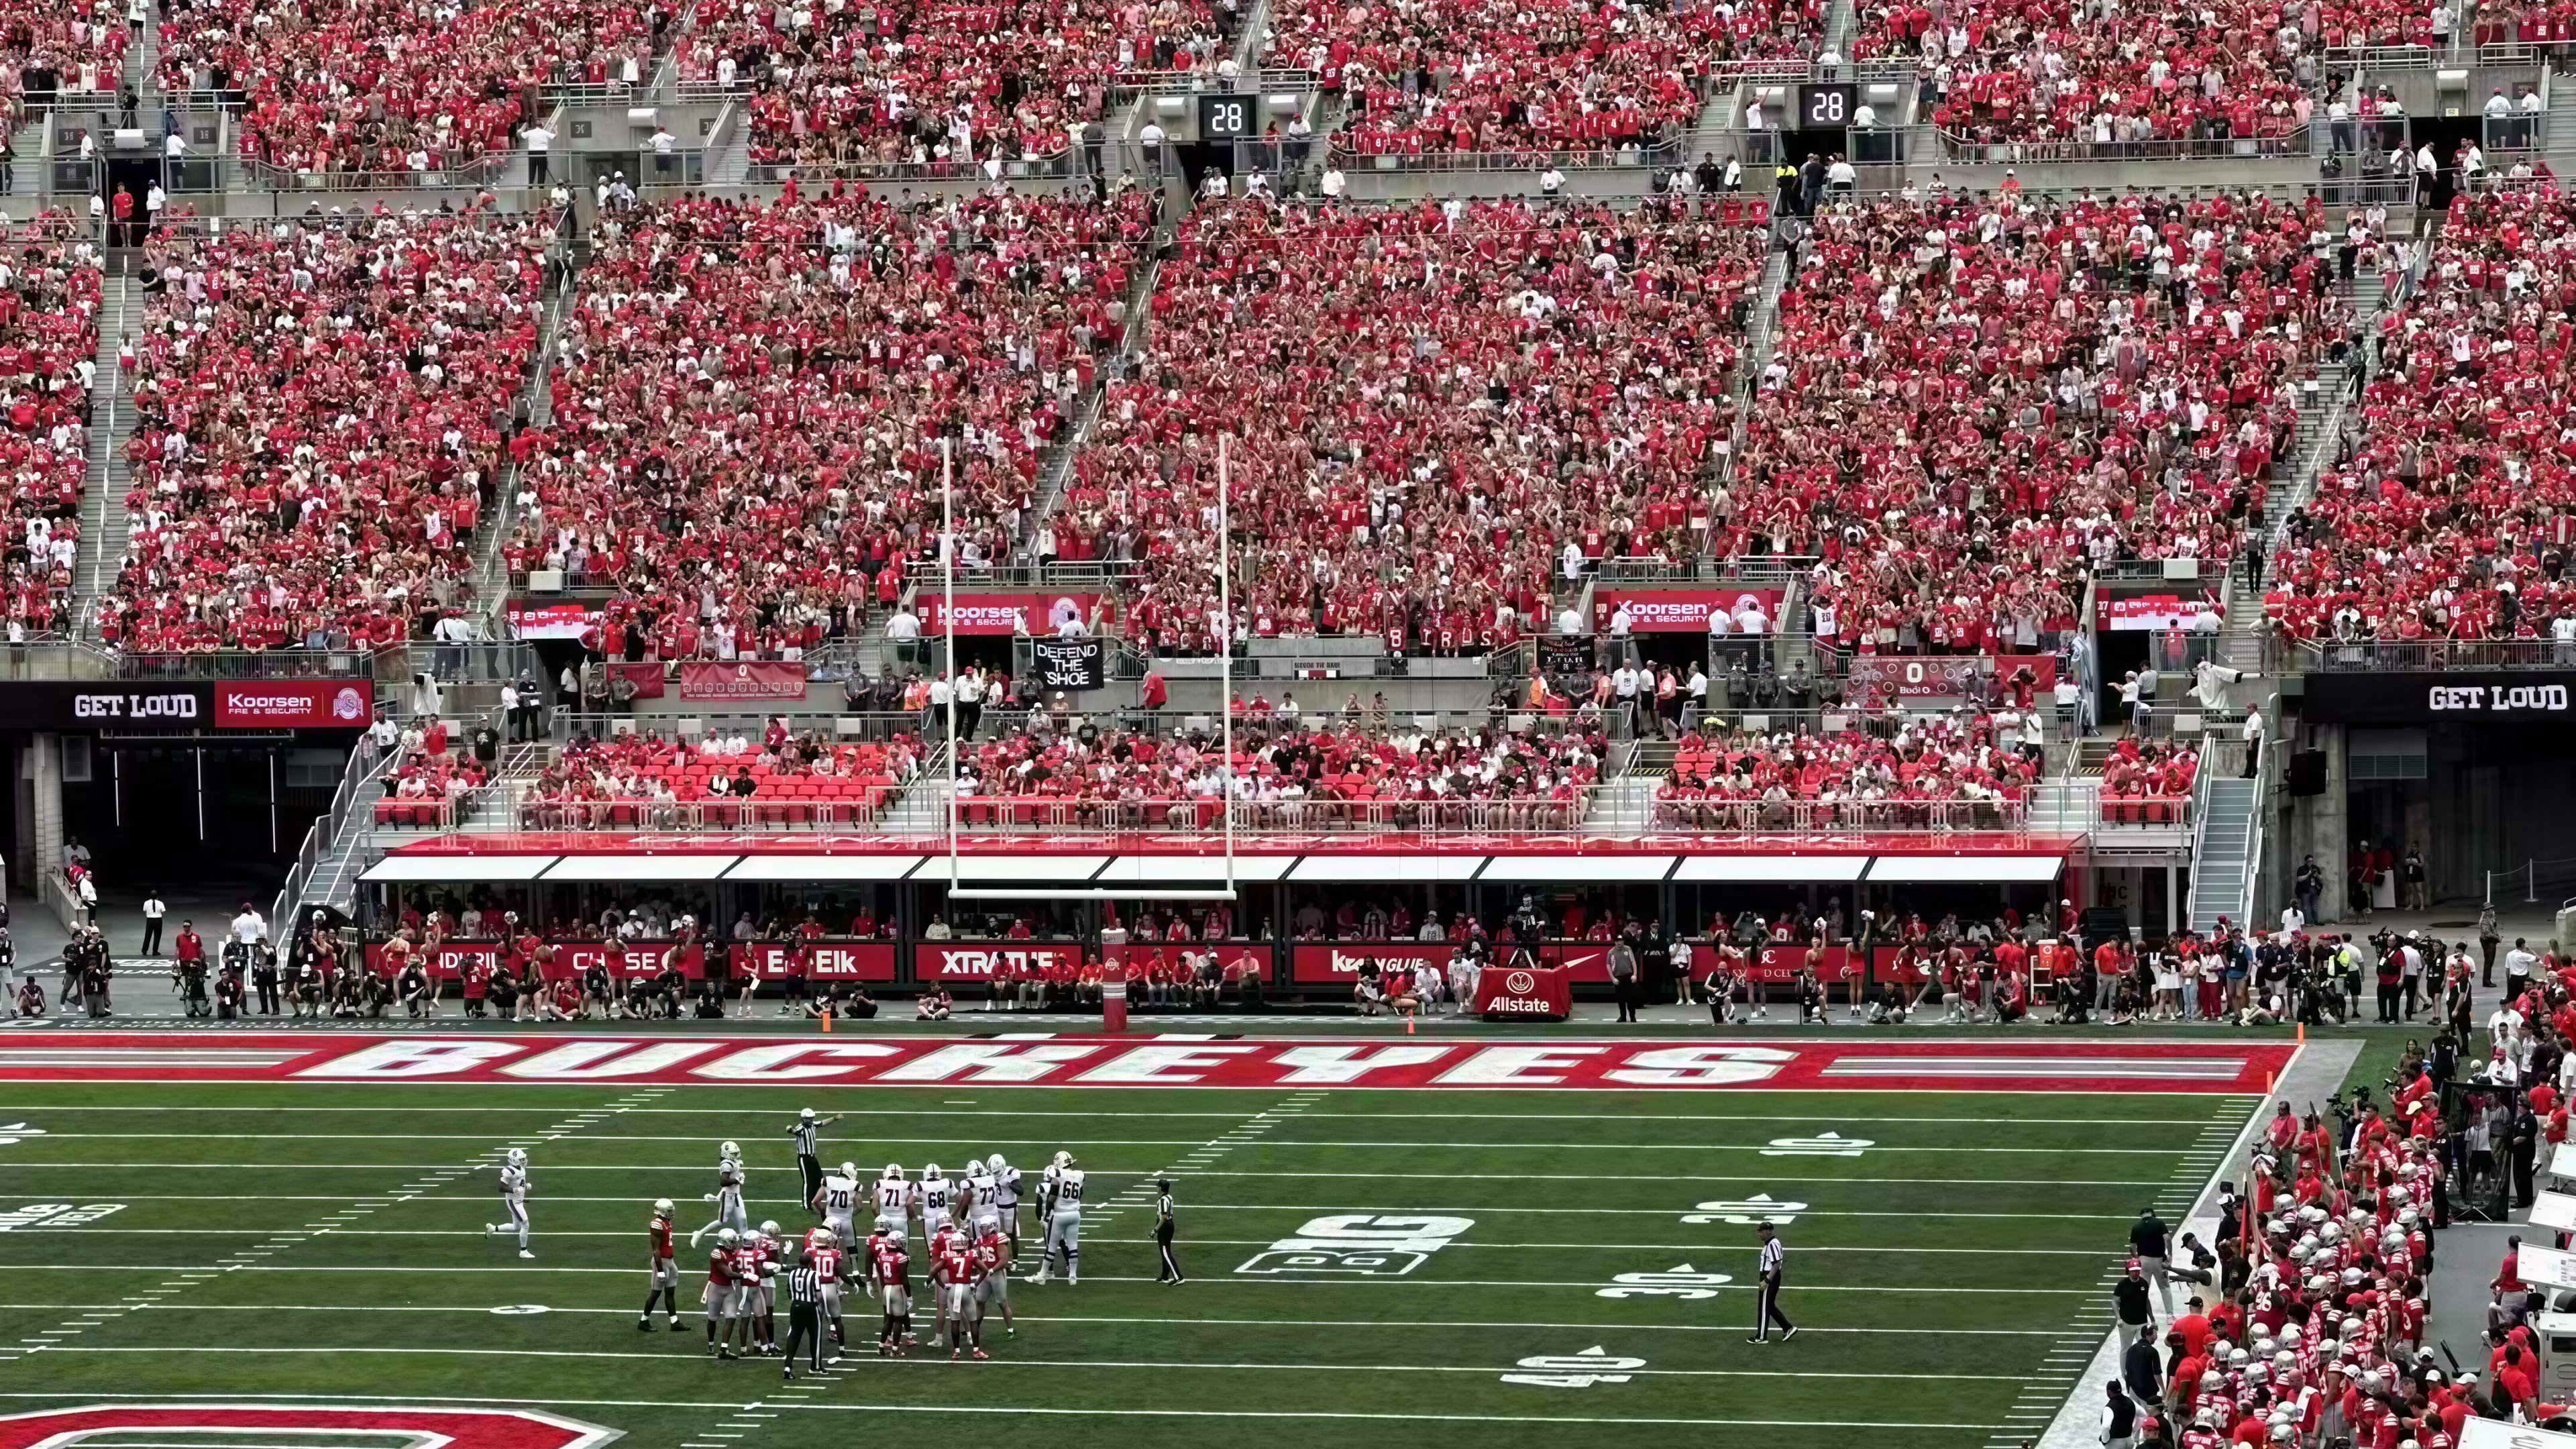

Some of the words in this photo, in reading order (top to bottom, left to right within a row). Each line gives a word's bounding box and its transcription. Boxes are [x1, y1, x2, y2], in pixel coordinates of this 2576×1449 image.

[1813, 92, 1843, 121] 28
[1212, 103, 1242, 131] 28
[2457, 340, 2462, 350] 4
[2267, 350, 2271, 360] 1
[1617, 600, 1707, 614] Koorsen
[2468, 621, 2471, 633] 1
[1036, 643, 1097, 659] DEFEND
[1052, 658, 1083, 672] THE
[75, 694, 123, 717] GET
[129, 694, 197, 718] LOUD
[228, 693, 313, 707] Koorsen
[2429, 686, 2485, 710] GET
[2491, 684, 2568, 710] LOUD
[573, 952, 656, 971] CHSE
[816, 950, 858, 973] Elk
[1487, 997, 1550, 1013] Allstate
[286, 1040, 1801, 1085] BUCKEYES
[1759, 1138, 1876, 1157] 10
[830, 1189, 848, 1209] 70
[885, 1189, 900, 1207] 71
[979, 1187, 996, 1205] 77
[1062, 1181, 1080, 1199] 66
[928, 1191, 946, 1209] 68
[1680, 1201, 1809, 1224] 20
[814, 1256, 834, 1277] 10
[953, 1257, 965, 1278] 7
[1595, 1273, 1733, 1299] 30
[1499, 1356, 1647, 1387] 40
